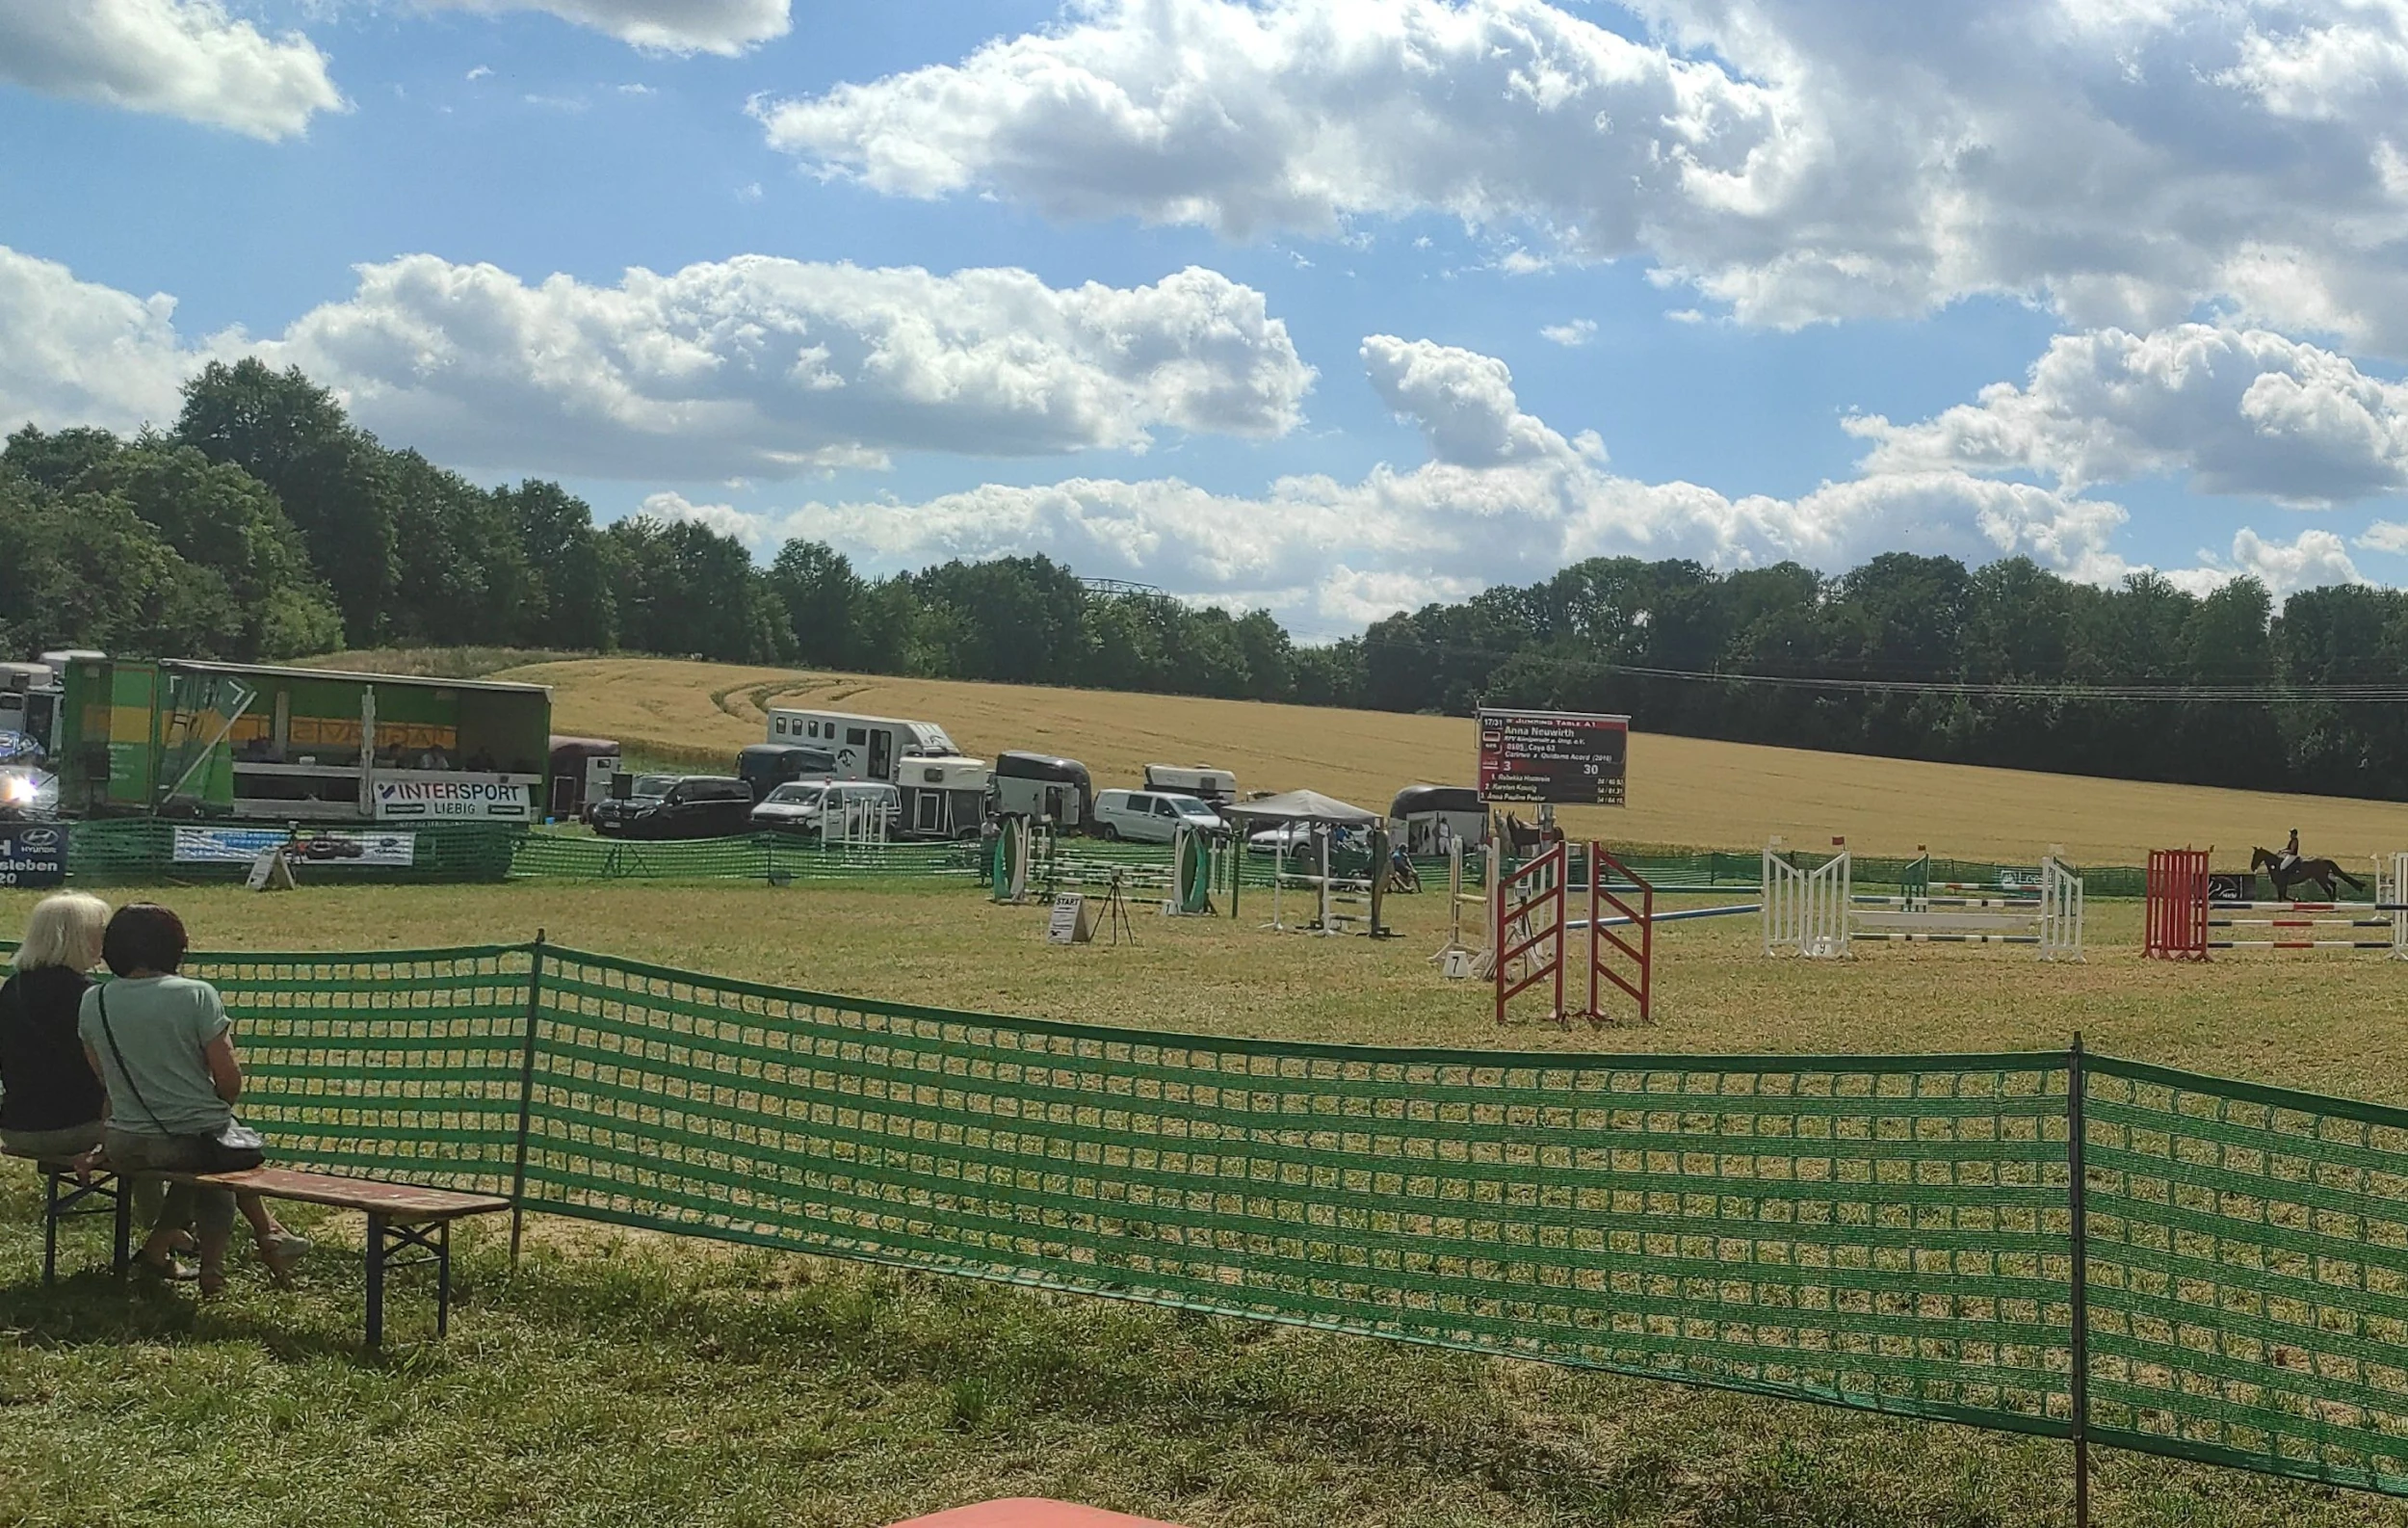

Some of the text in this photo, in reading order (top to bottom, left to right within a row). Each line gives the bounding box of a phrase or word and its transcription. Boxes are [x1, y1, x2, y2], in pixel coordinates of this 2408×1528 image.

[1505, 725, 1575, 737] Anna Neuwirth
[1503, 760, 1511, 771] 3
[1584, 764, 1599, 775] 30
[399, 782, 519, 801] INTERSPORT
[434, 803, 476, 814] LIEBIG
[1452, 956, 1460, 974] 7
